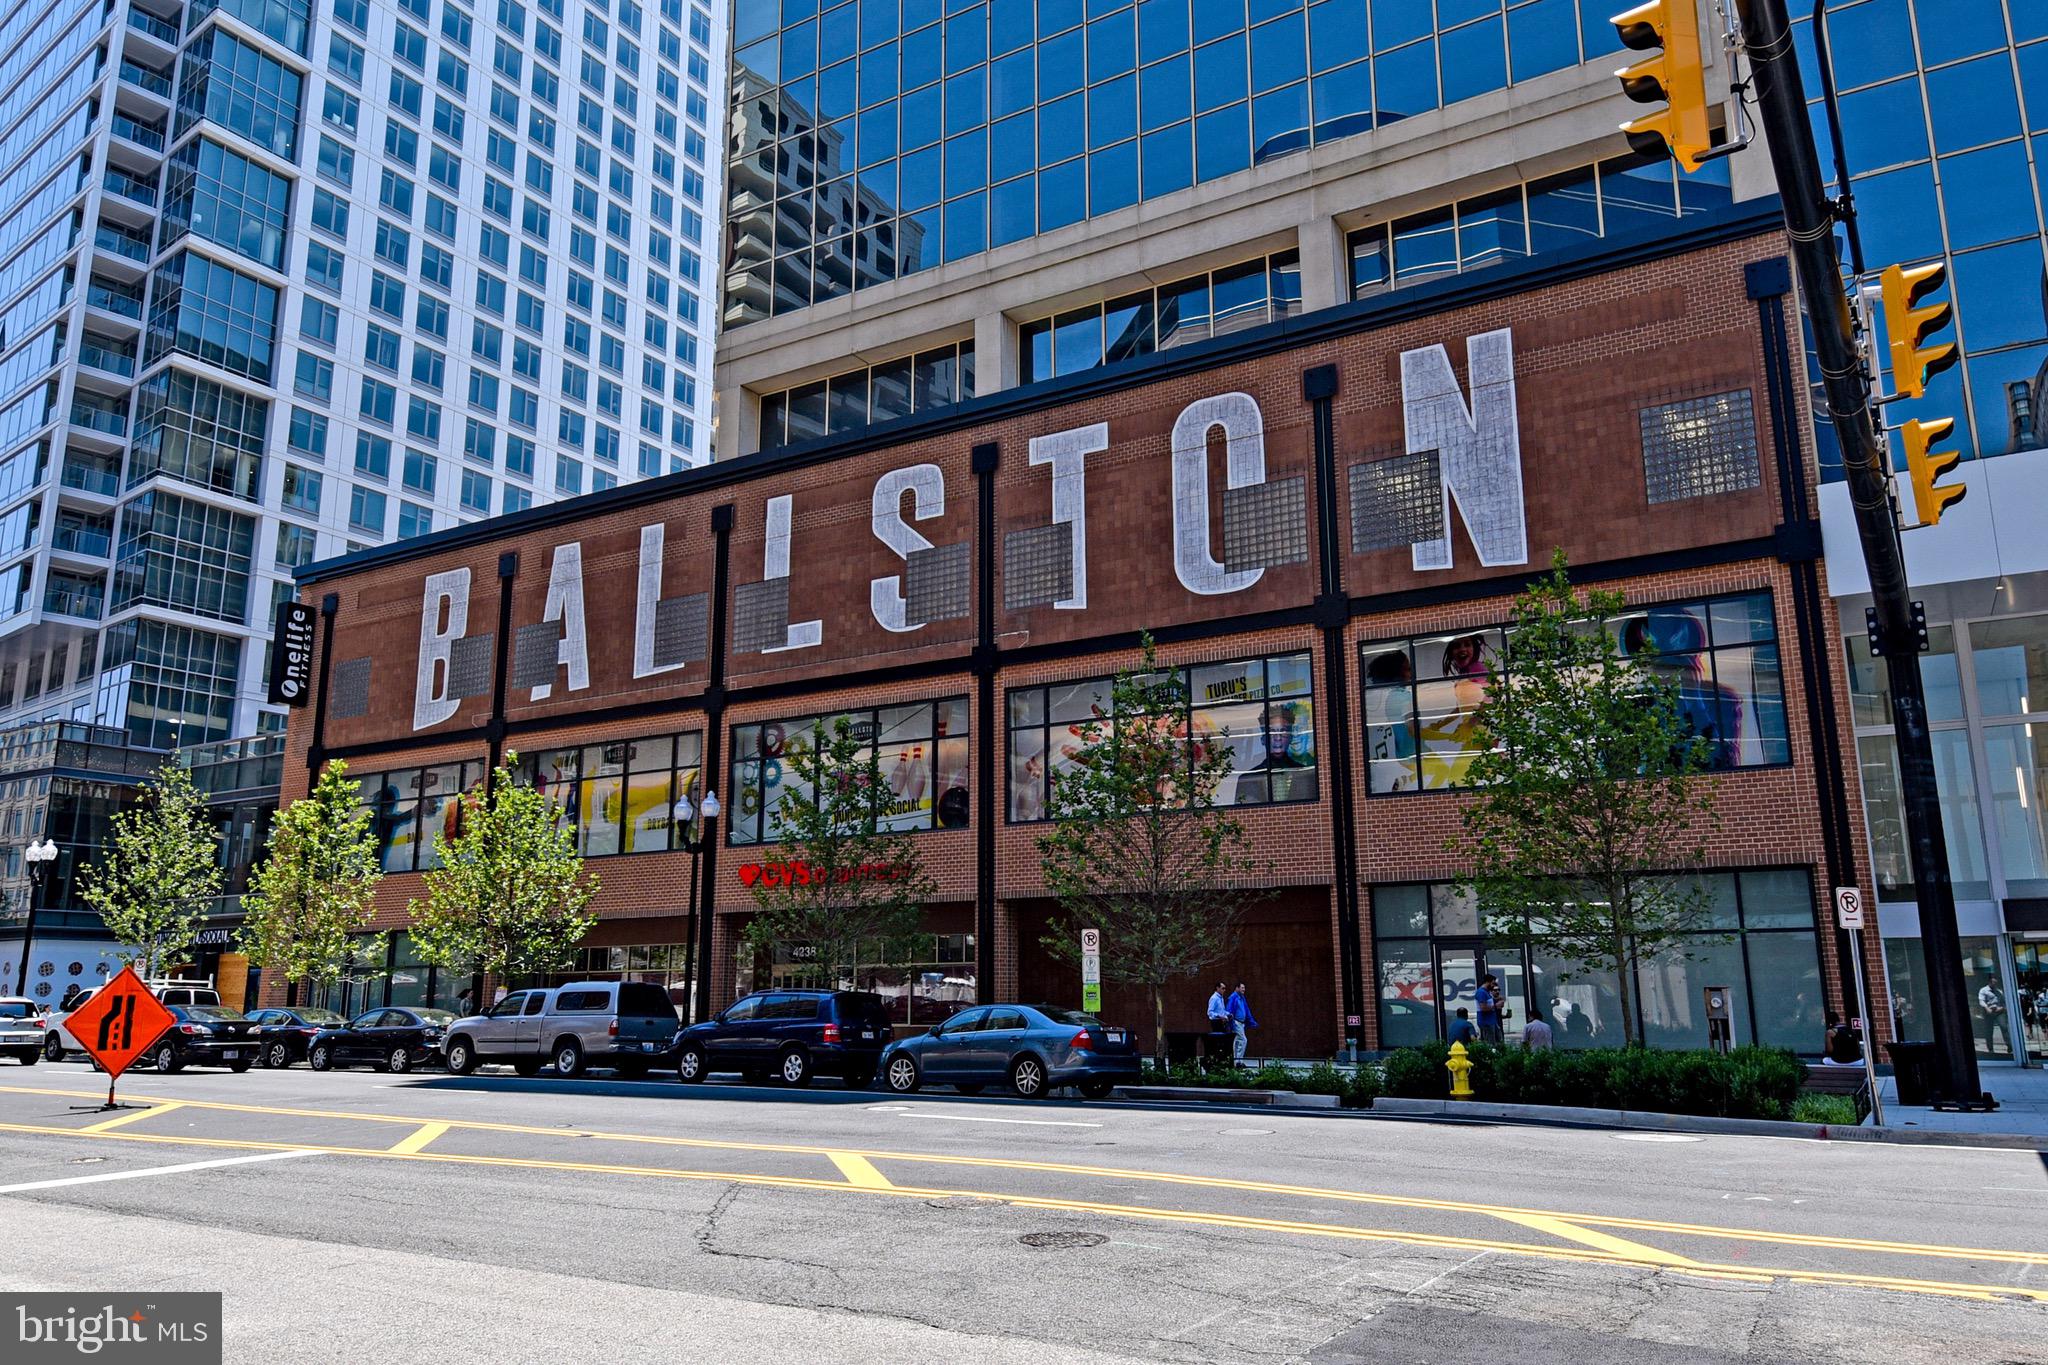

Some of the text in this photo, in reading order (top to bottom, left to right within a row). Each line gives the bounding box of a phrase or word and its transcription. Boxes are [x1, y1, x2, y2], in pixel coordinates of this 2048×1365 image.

[299, 624, 313, 689] FITNESS
[1207, 677, 1247, 699] TURU'S
[1249, 688, 1266, 700] PIZZ
[1270, 684, 1284, 694] CO.
[890, 799, 922, 815] SOCIAL
[762, 860, 809, 887] CVS
